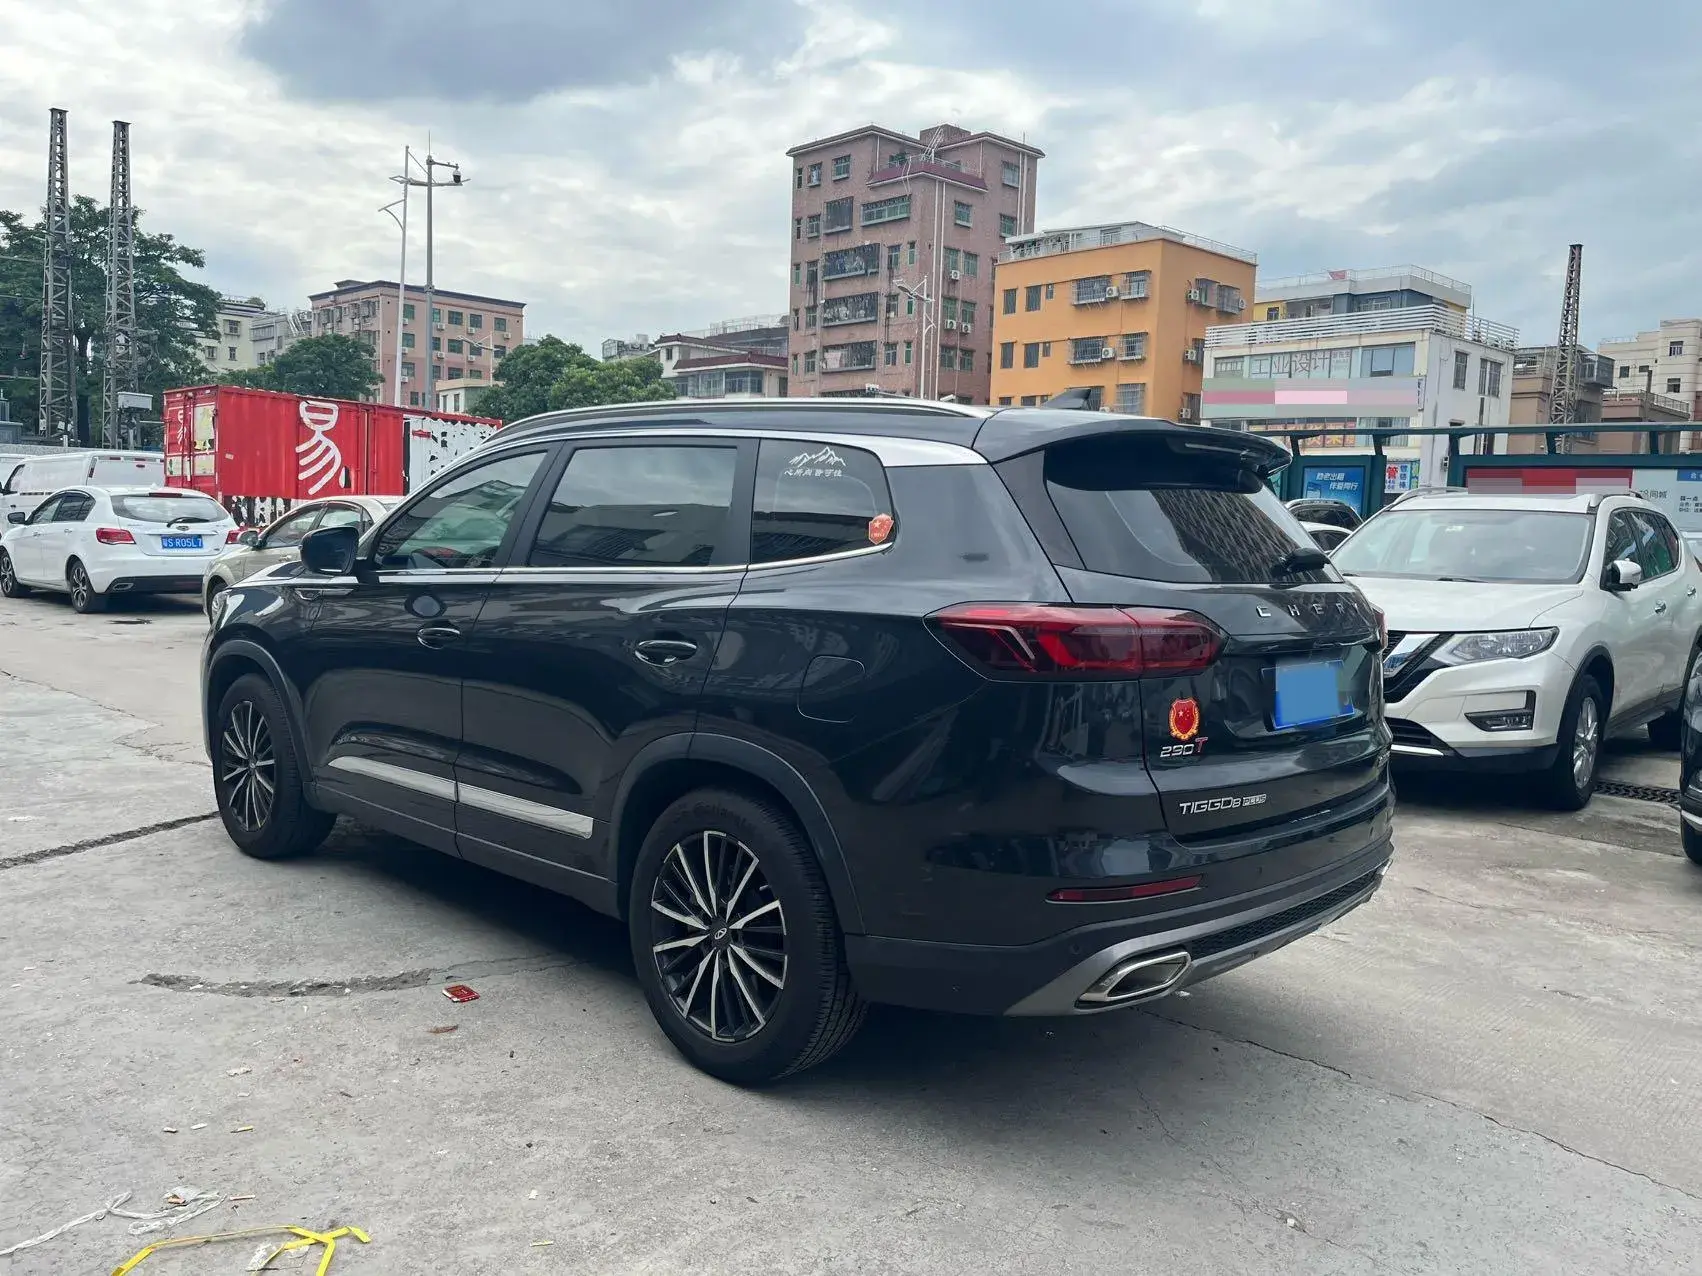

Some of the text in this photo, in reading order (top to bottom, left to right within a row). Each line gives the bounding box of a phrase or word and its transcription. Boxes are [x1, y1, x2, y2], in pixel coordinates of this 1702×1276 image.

[1251, 352, 1330, 374] 工业设计
[1256, 602, 1361, 617] CHERY
[1160, 737, 1208, 758] 290T
[1179, 796, 1241, 815] TIGGO8
